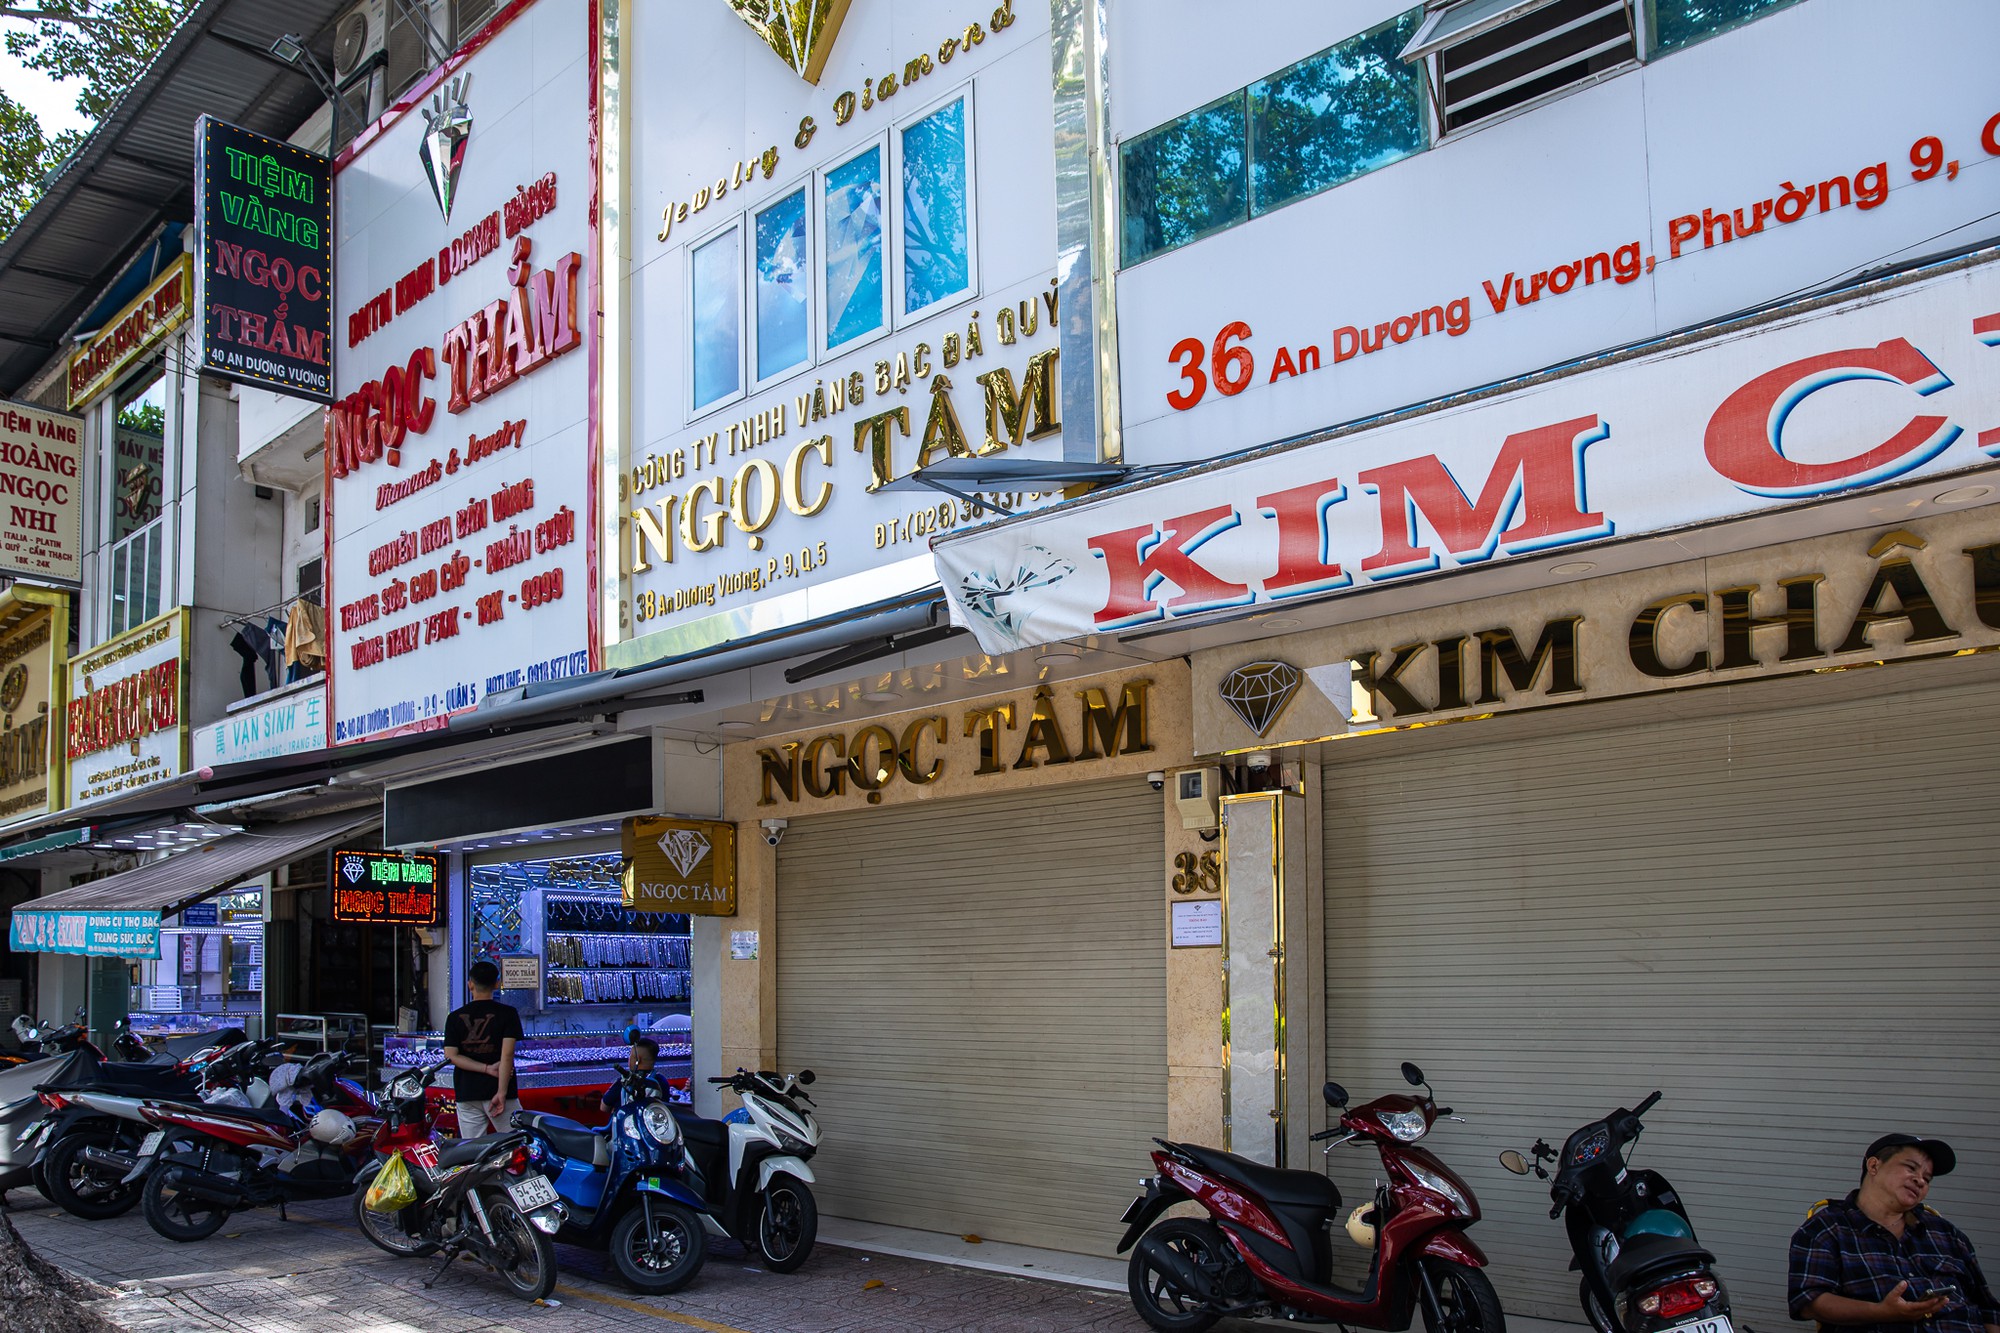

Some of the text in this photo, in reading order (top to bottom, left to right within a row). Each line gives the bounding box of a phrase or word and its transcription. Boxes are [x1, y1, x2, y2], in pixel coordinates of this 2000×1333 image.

[657, 0, 1017, 242] Jewelry & Diamond
[225, 147, 313, 204] TIỆM
[220, 191, 319, 249] VÀNG
[215, 239, 321, 302] NGỌC
[1166, 135, 1959, 411] 36 An Dương Vương, Phường 9,
[212, 302, 326, 365] THẮM
[211, 348, 326, 388] 40 AN DƯƠNG VƯƠNG
[331, 346, 436, 479] NGỌC
[632, 447, 685, 496] CÔNG
[691, 432, 718, 470] TY
[725, 403, 786, 456] TNHH
[795, 371, 865, 428] VÀNG
[874, 342, 931, 396] BẠC
[942, 310, 983, 370] ĐÁ
[37, 419, 77, 444] VÀNG
[0, 441, 77, 477] HOÀNG
[376, 418, 527, 511] Diamonds & Jewelry
[632, 347, 1061, 574] NGỌC TÂM
[1087, 312, 2000, 632] KIM C
[0, 472, 69, 506] NGỌC
[4, 531, 27, 543] ITALIA
[36, 537, 61, 549] PLATIN
[9, 505, 57, 534] NHI
[368, 478, 534, 577] CHUYÊN MUA BÁN VÀNG
[14, 556, 29, 566] 18K
[36, 559, 51, 569] 24K
[48, 551, 73, 562] THẠCH
[340, 594, 379, 632] TRANG
[409, 569, 437, 604] CAO
[440, 550, 470, 592] CẤP
[636, 589, 656, 623] 38
[658, 594, 674, 616] An
[675, 582, 716, 611] Dương
[351, 636, 384, 670] VÀNG
[386, 621, 419, 659] ITALY
[423, 606, 460, 645] 750K
[476, 590, 504, 627] 18K
[521, 567, 563, 610] 9999
[1344, 614, 1585, 725] KIM
[233, 704, 296, 751] VẠN SINH
[756, 679, 1156, 808] NGỌC TÂM
[370, 858, 433, 885] TIỆM VÀNG
[641, 882, 727, 903] NGỌC TÂM
[1172, 849, 1221, 894] 38
[89, 916, 111, 929] DỤNG
[112, 916, 122, 929] CỤ
[142, 916, 159, 929] BẠC
[340, 890, 384, 917] NGỌC
[58, 915, 87, 947] SINH
[94, 932, 118, 943] TRANG
[136, 933, 154, 946] BẠC
[516, 1179, 546, 1198] 54-H4
[1422, 1201, 1445, 1216] HONDA
[1675, 1316, 1699, 1326] HONDA
